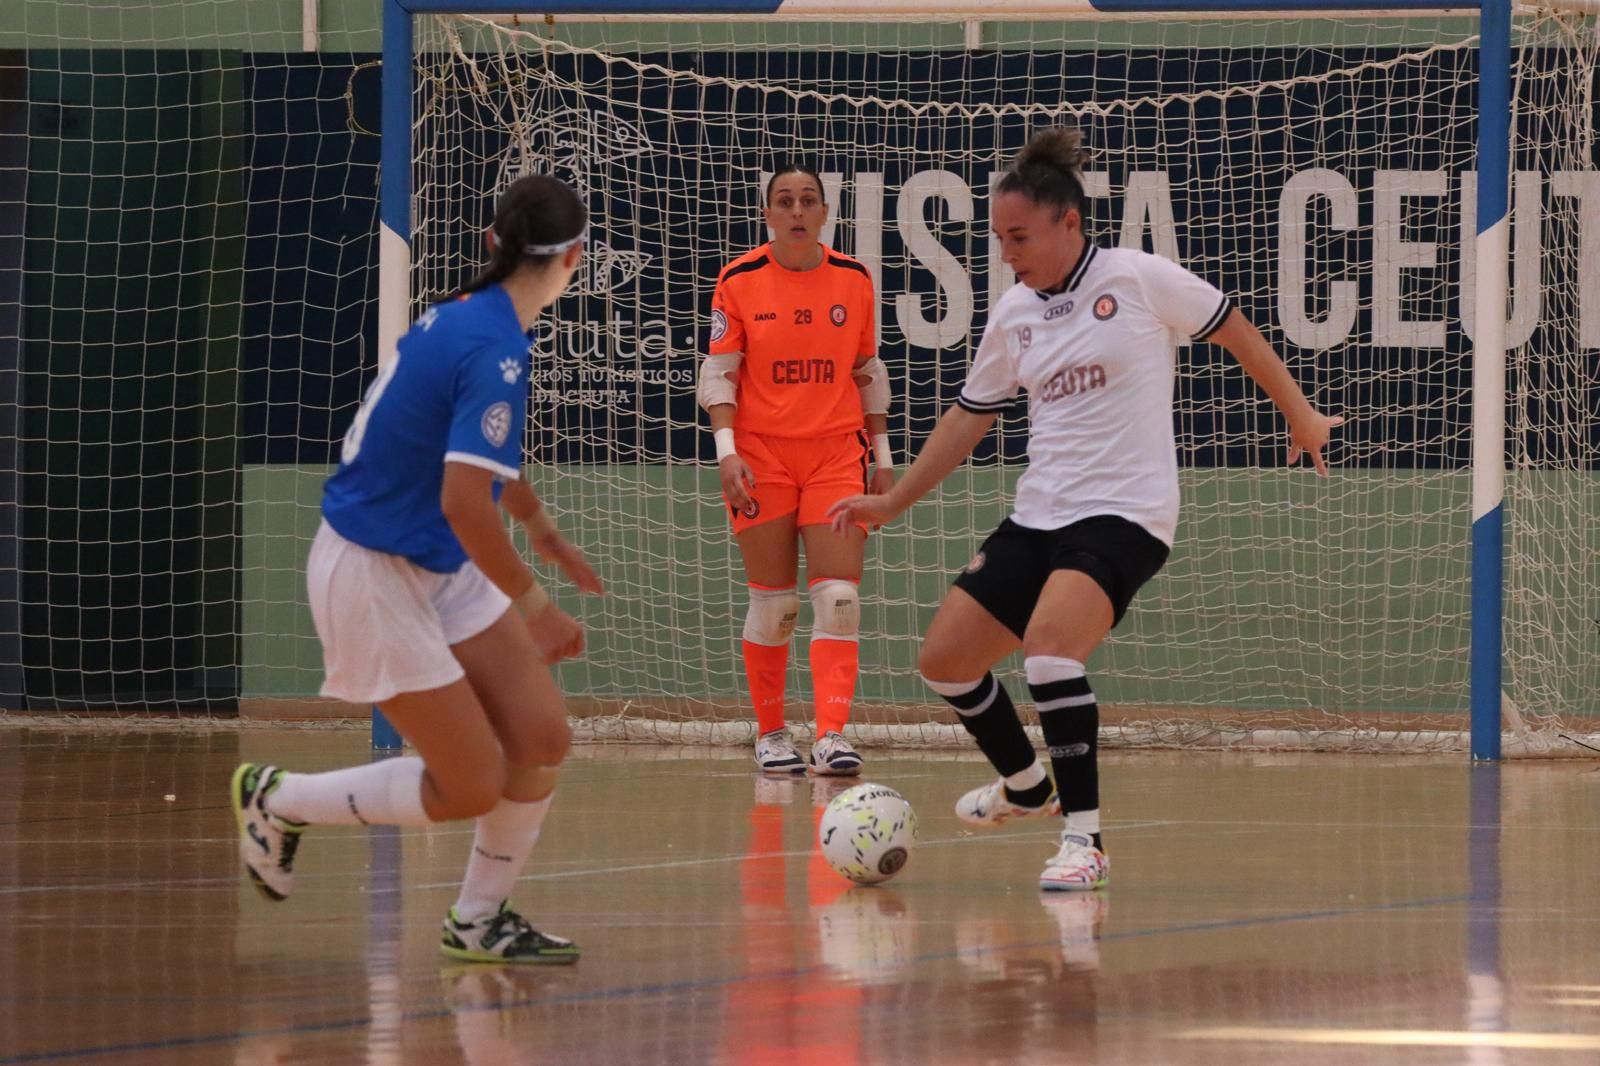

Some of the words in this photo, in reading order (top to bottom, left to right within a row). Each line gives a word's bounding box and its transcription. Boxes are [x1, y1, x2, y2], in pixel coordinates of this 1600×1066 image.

[754, 312, 777, 321] JAKO
[794, 309, 812, 325] 28
[772, 358, 835, 385] CEUTA
[1041, 364, 1106, 402] CEUTA
